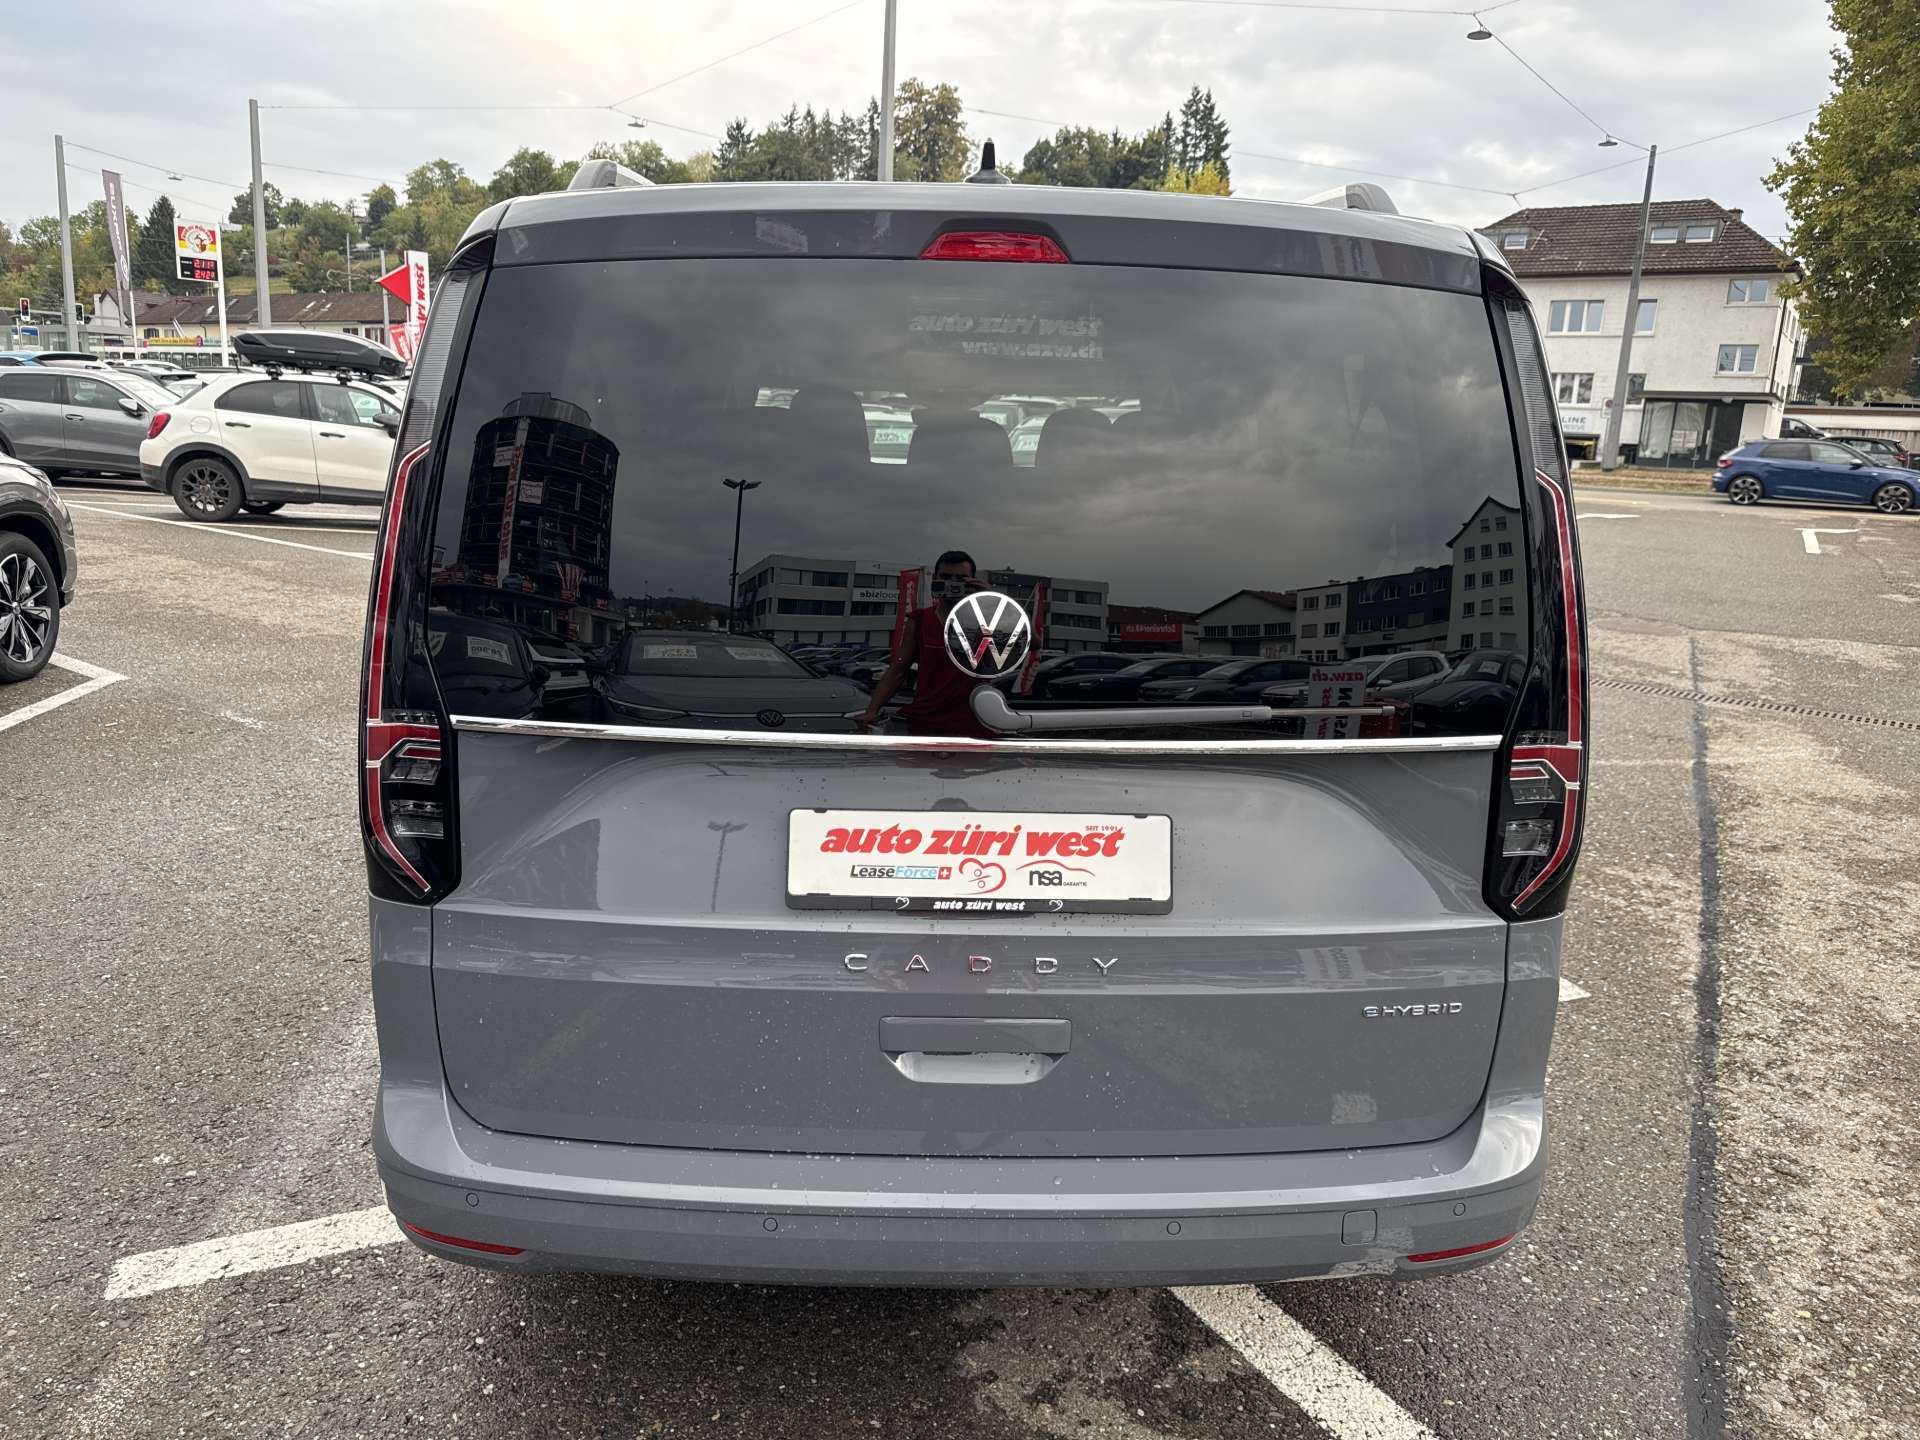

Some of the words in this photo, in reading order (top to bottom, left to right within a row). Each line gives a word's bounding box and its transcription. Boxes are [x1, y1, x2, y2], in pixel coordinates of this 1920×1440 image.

[415, 262, 426, 301] west
[820, 823, 923, 854] auto
[923, 824, 1022, 856] züri
[1026, 826, 1126, 858] west
[850, 864, 938, 879] LeaseForce
[1029, 870, 1062, 887] nsa
[933, 900, 963, 910] auto
[964, 900, 994, 911] züri
[995, 901, 1026, 911] west
[844, 953, 1119, 976] CADDY
